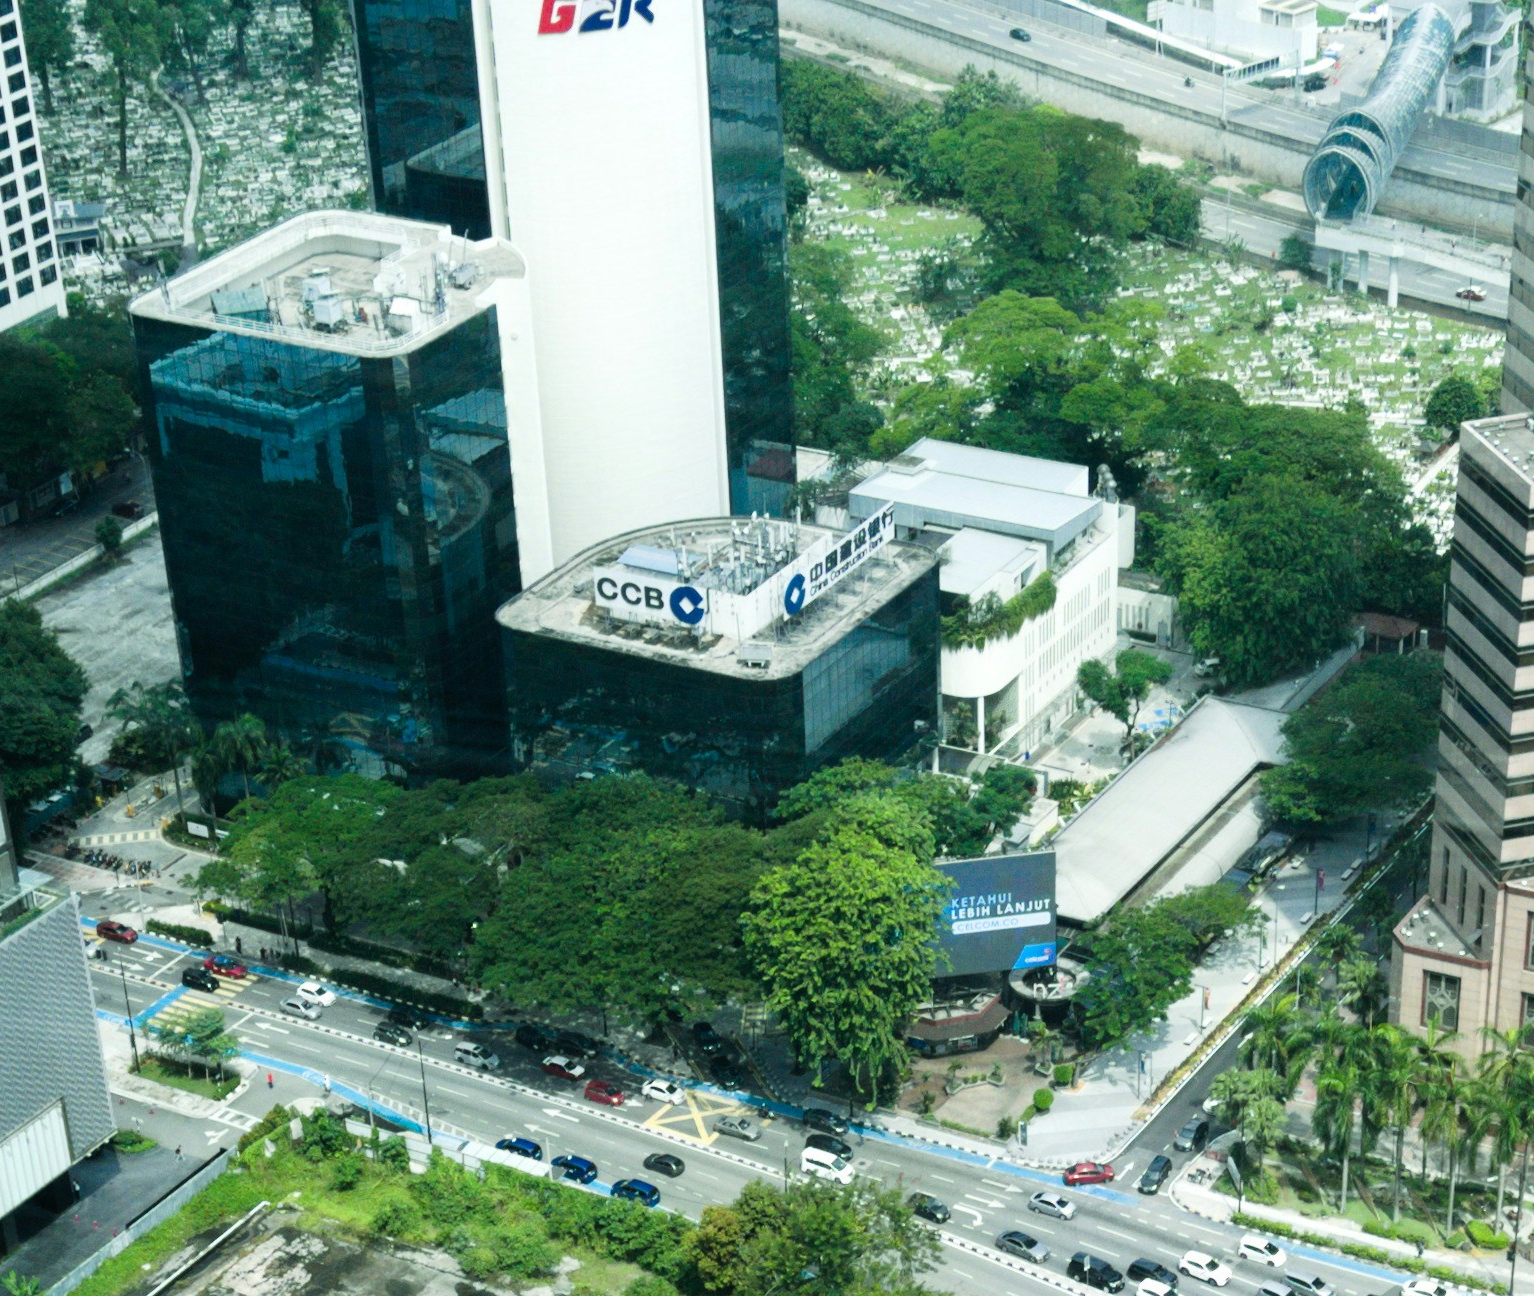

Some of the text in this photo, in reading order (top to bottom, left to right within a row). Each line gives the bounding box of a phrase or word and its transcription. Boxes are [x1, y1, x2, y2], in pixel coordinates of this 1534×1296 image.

[596, 577, 665, 610] CCB
[951, 892, 1012, 909] KETAHUI
[951, 898, 1051, 920] LEBIH LANJUT
